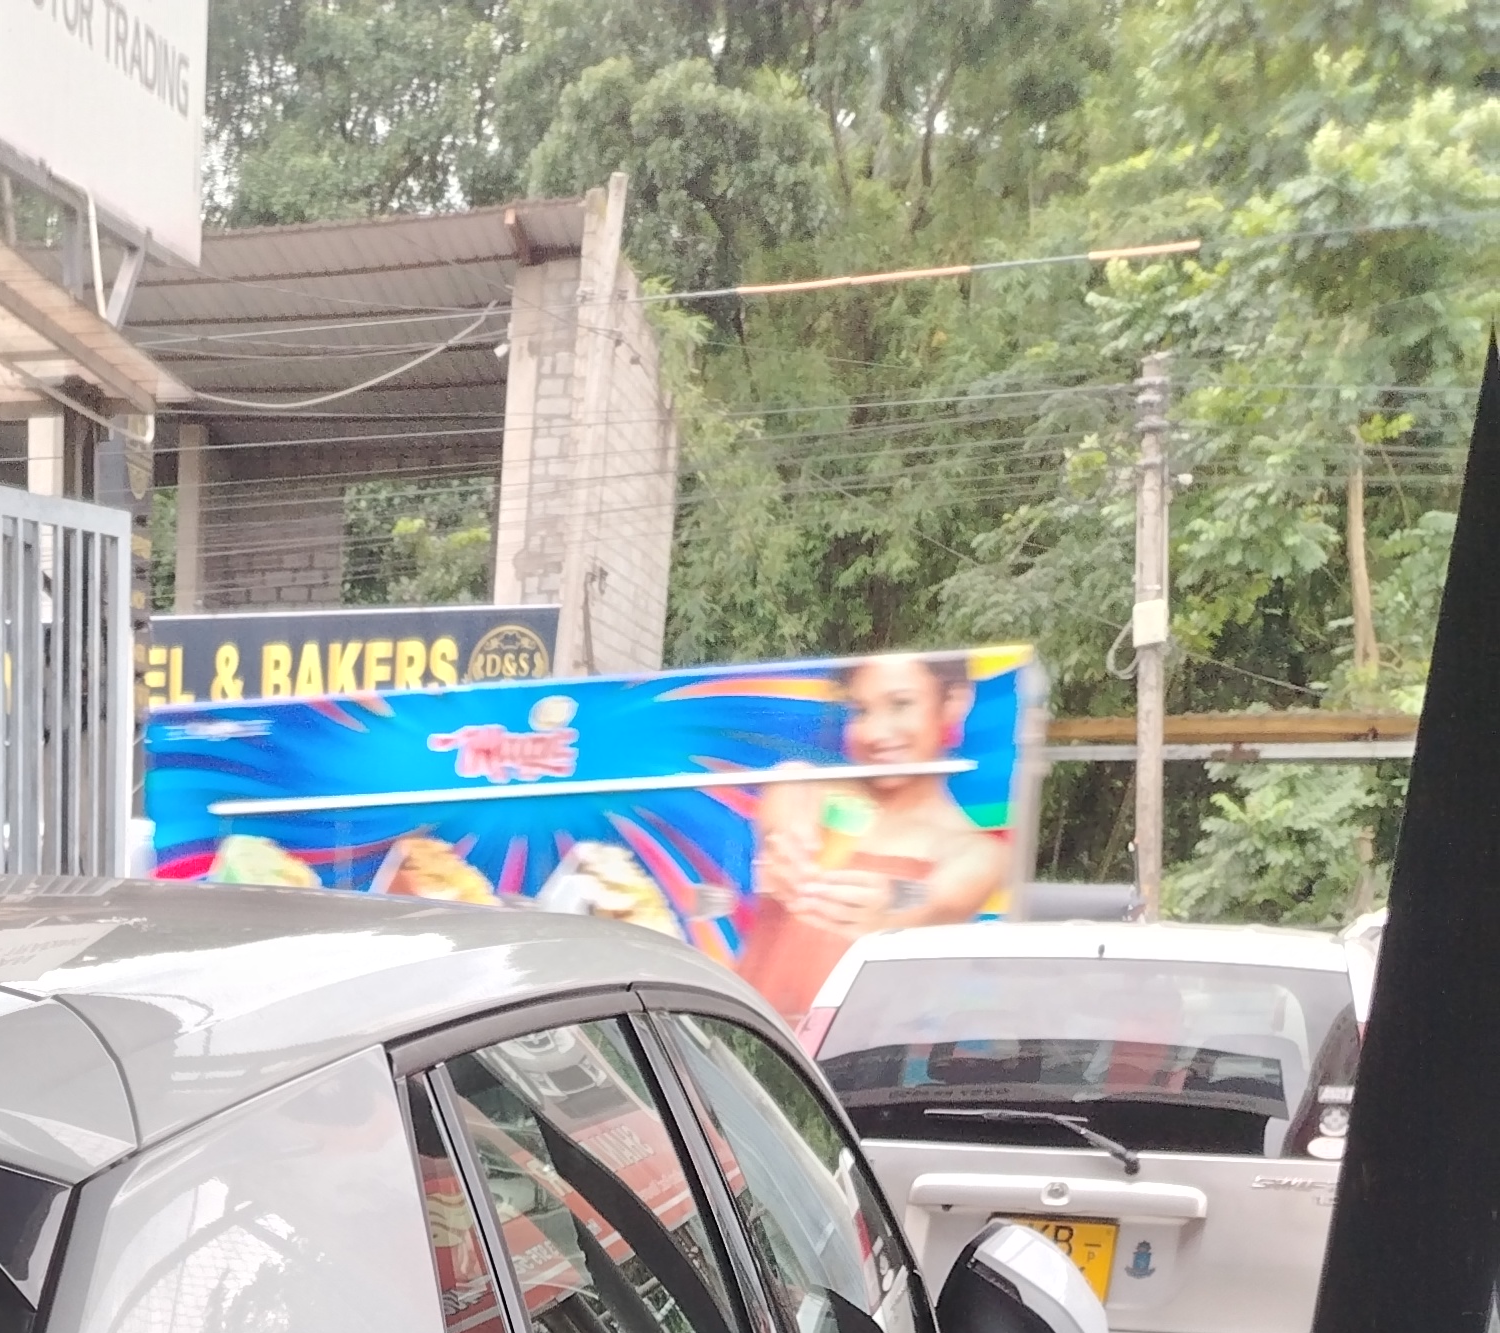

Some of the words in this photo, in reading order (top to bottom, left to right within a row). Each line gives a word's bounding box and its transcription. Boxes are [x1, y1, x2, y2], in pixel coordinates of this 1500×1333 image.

[103, 0, 190, 119] TRADING
[211, 643, 244, 701] &
[262, 637, 460, 697] BAKERS
[485, 653, 530, 677] D&S
